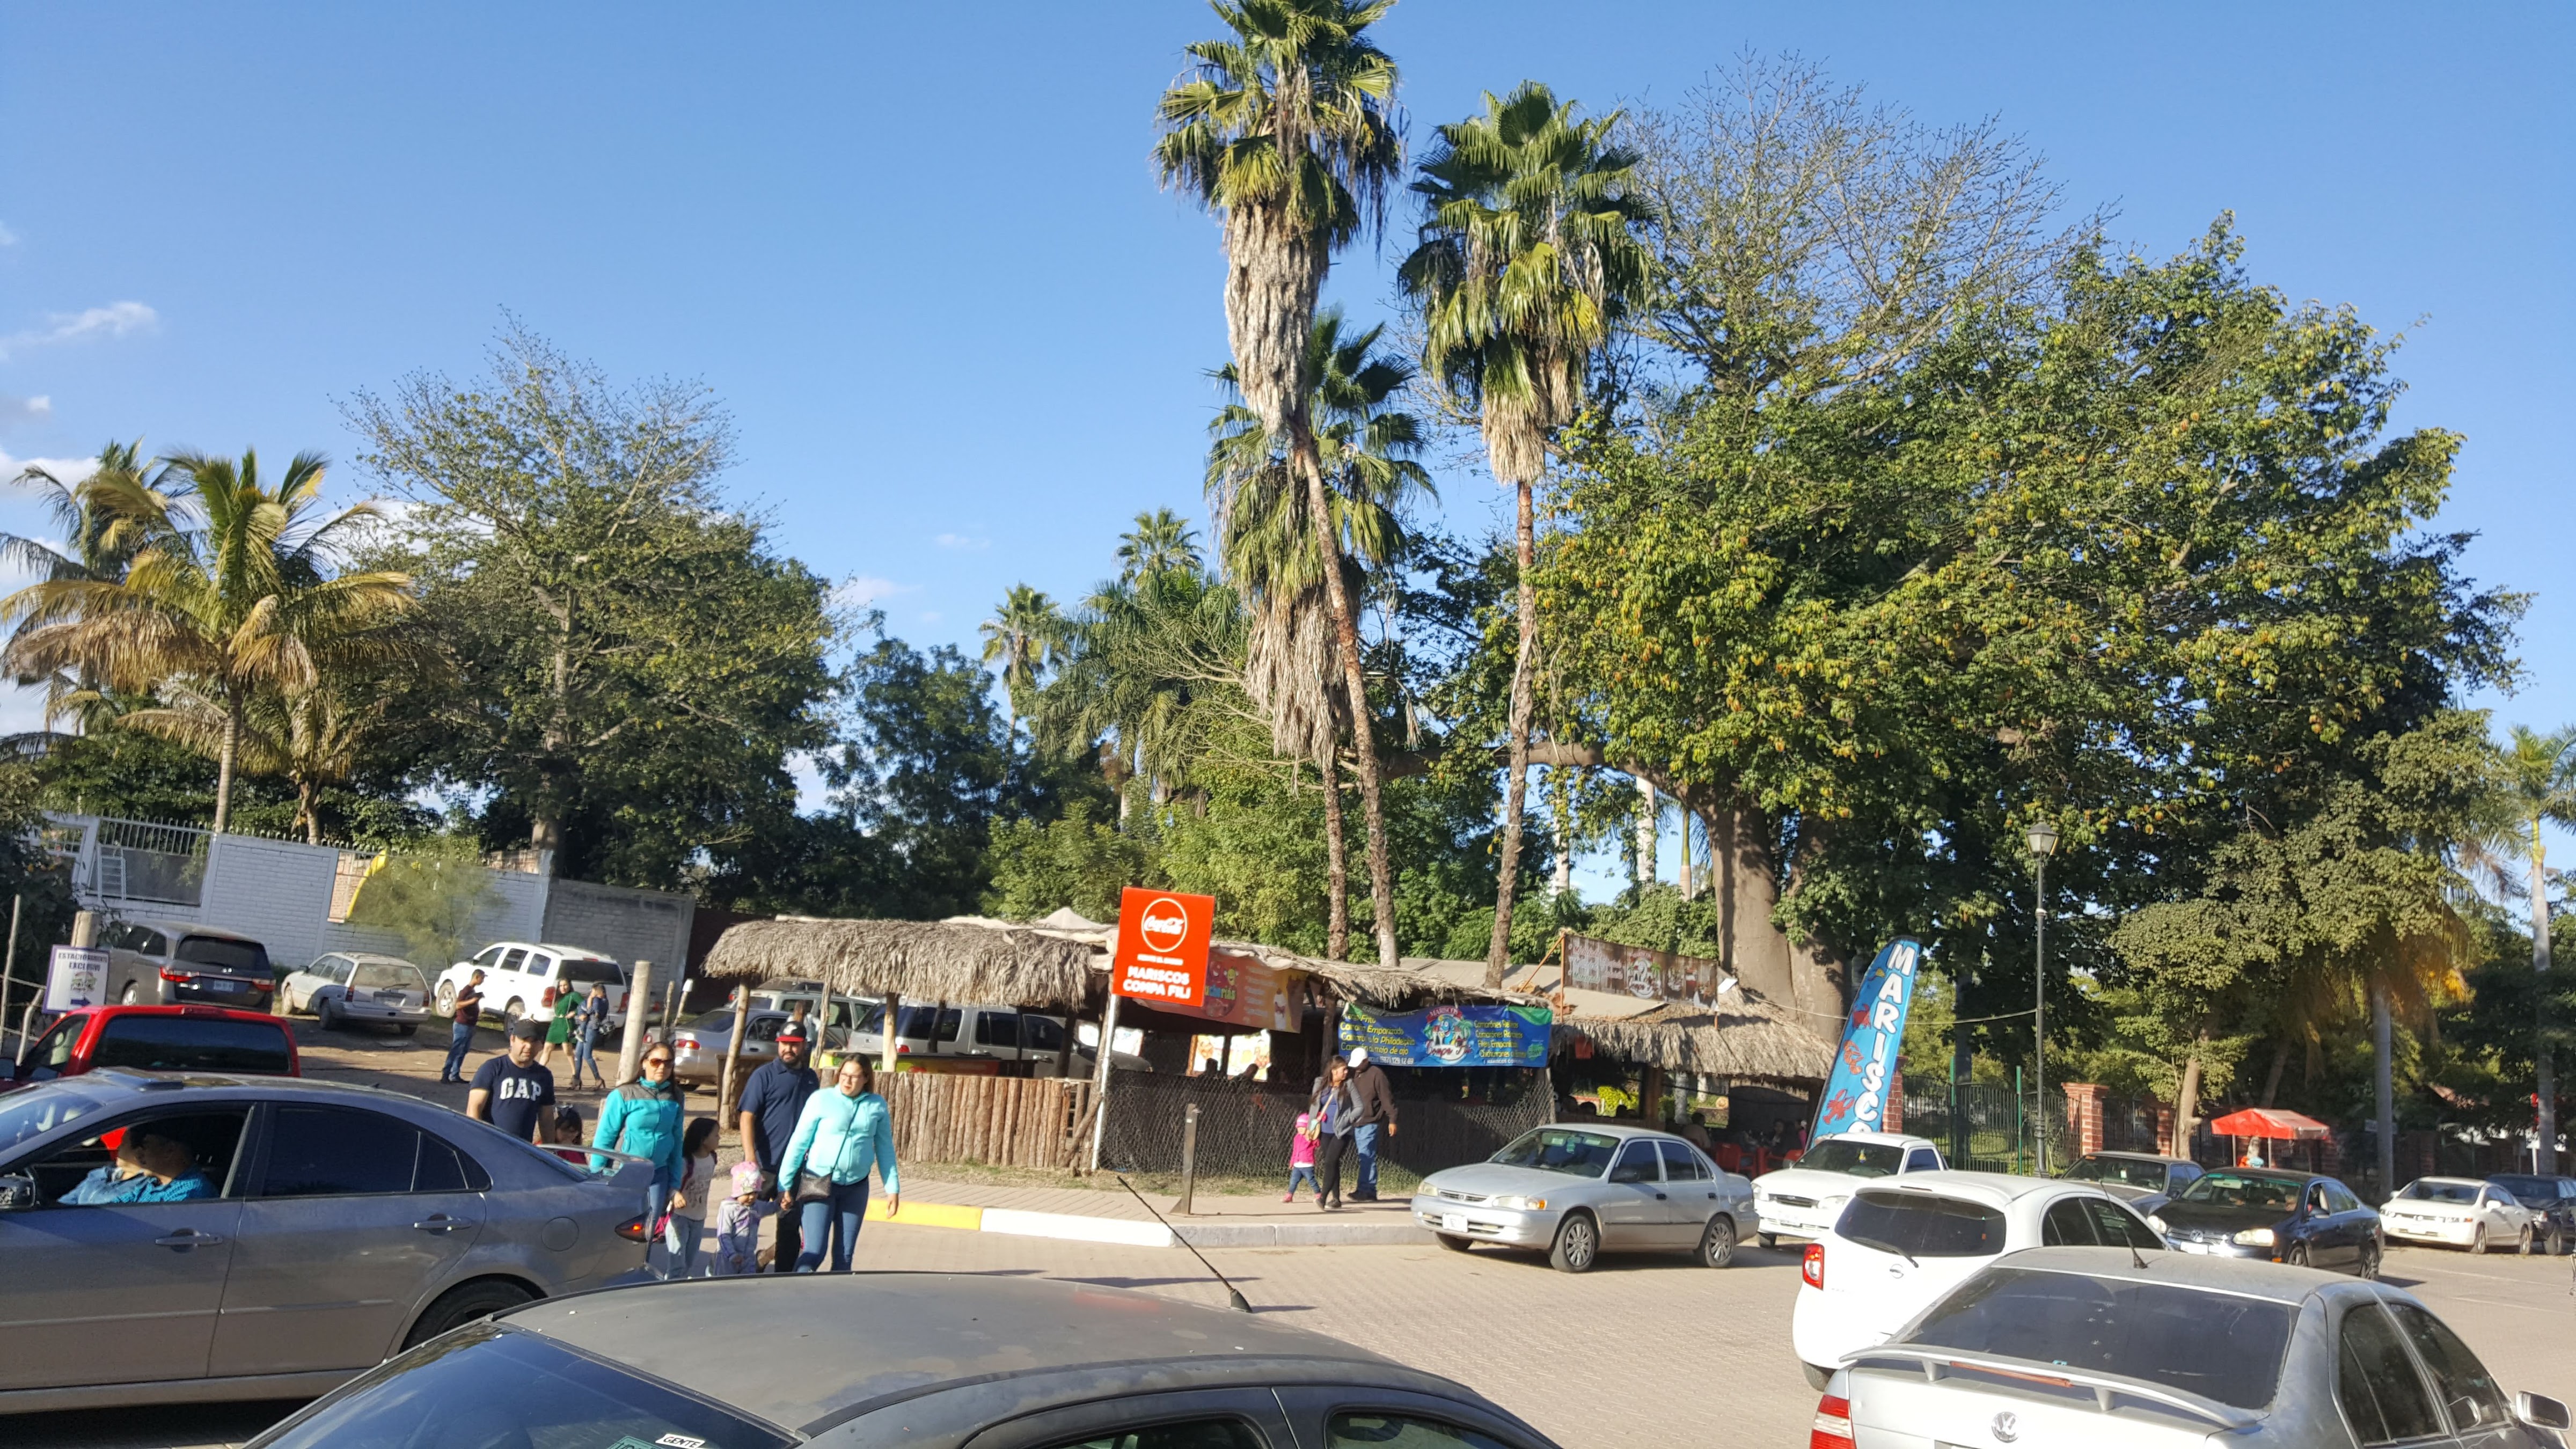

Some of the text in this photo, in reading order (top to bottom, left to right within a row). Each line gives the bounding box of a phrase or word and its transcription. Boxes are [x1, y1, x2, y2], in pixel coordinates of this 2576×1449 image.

[1128, 965, 1190, 985] MARISCOS
[1123, 978, 1166, 996] COMPA
[1167, 984, 1191, 999] FILI
[1389, 1046, 1397, 1055] de
[1399, 1048, 1409, 1056] ajo
[500, 1077, 542, 1102] GAP
[663, 1437, 701, 1448] GENTE
